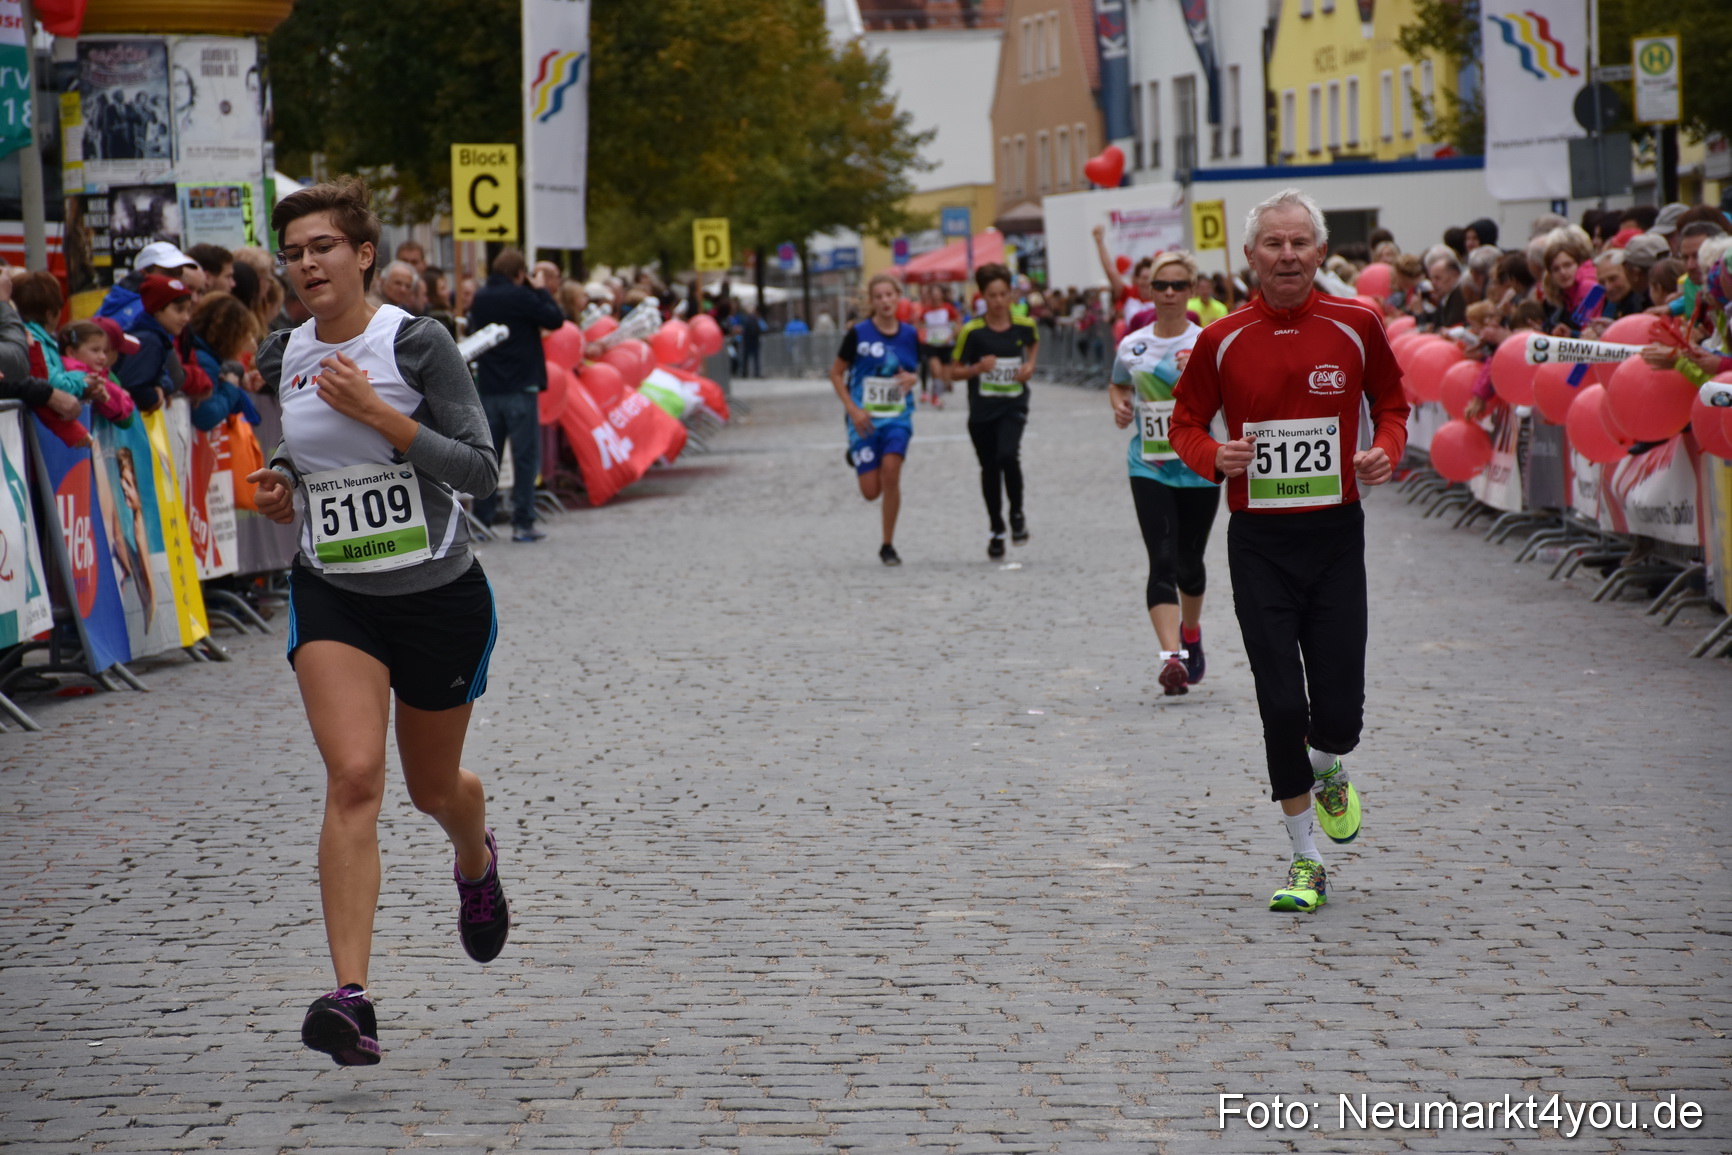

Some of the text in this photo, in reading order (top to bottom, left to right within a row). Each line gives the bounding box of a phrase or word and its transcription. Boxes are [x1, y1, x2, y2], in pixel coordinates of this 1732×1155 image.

[459, 149, 508, 166] Block
[469, 173, 499, 219] C
[1202, 216, 1219, 239] D
[704, 235, 721, 259] D
[1274, 328, 1295, 336] CRAFT
[1558, 340, 1594, 355] BMW
[1245, 427, 1323, 438] PARTL Neumarkt
[1256, 439, 1332, 475] 5123
[309, 471, 395, 494] PARTL Neumarkt
[1277, 482, 1310, 495] Horst
[321, 484, 412, 537] 5109
[342, 539, 396, 560] Nadine
